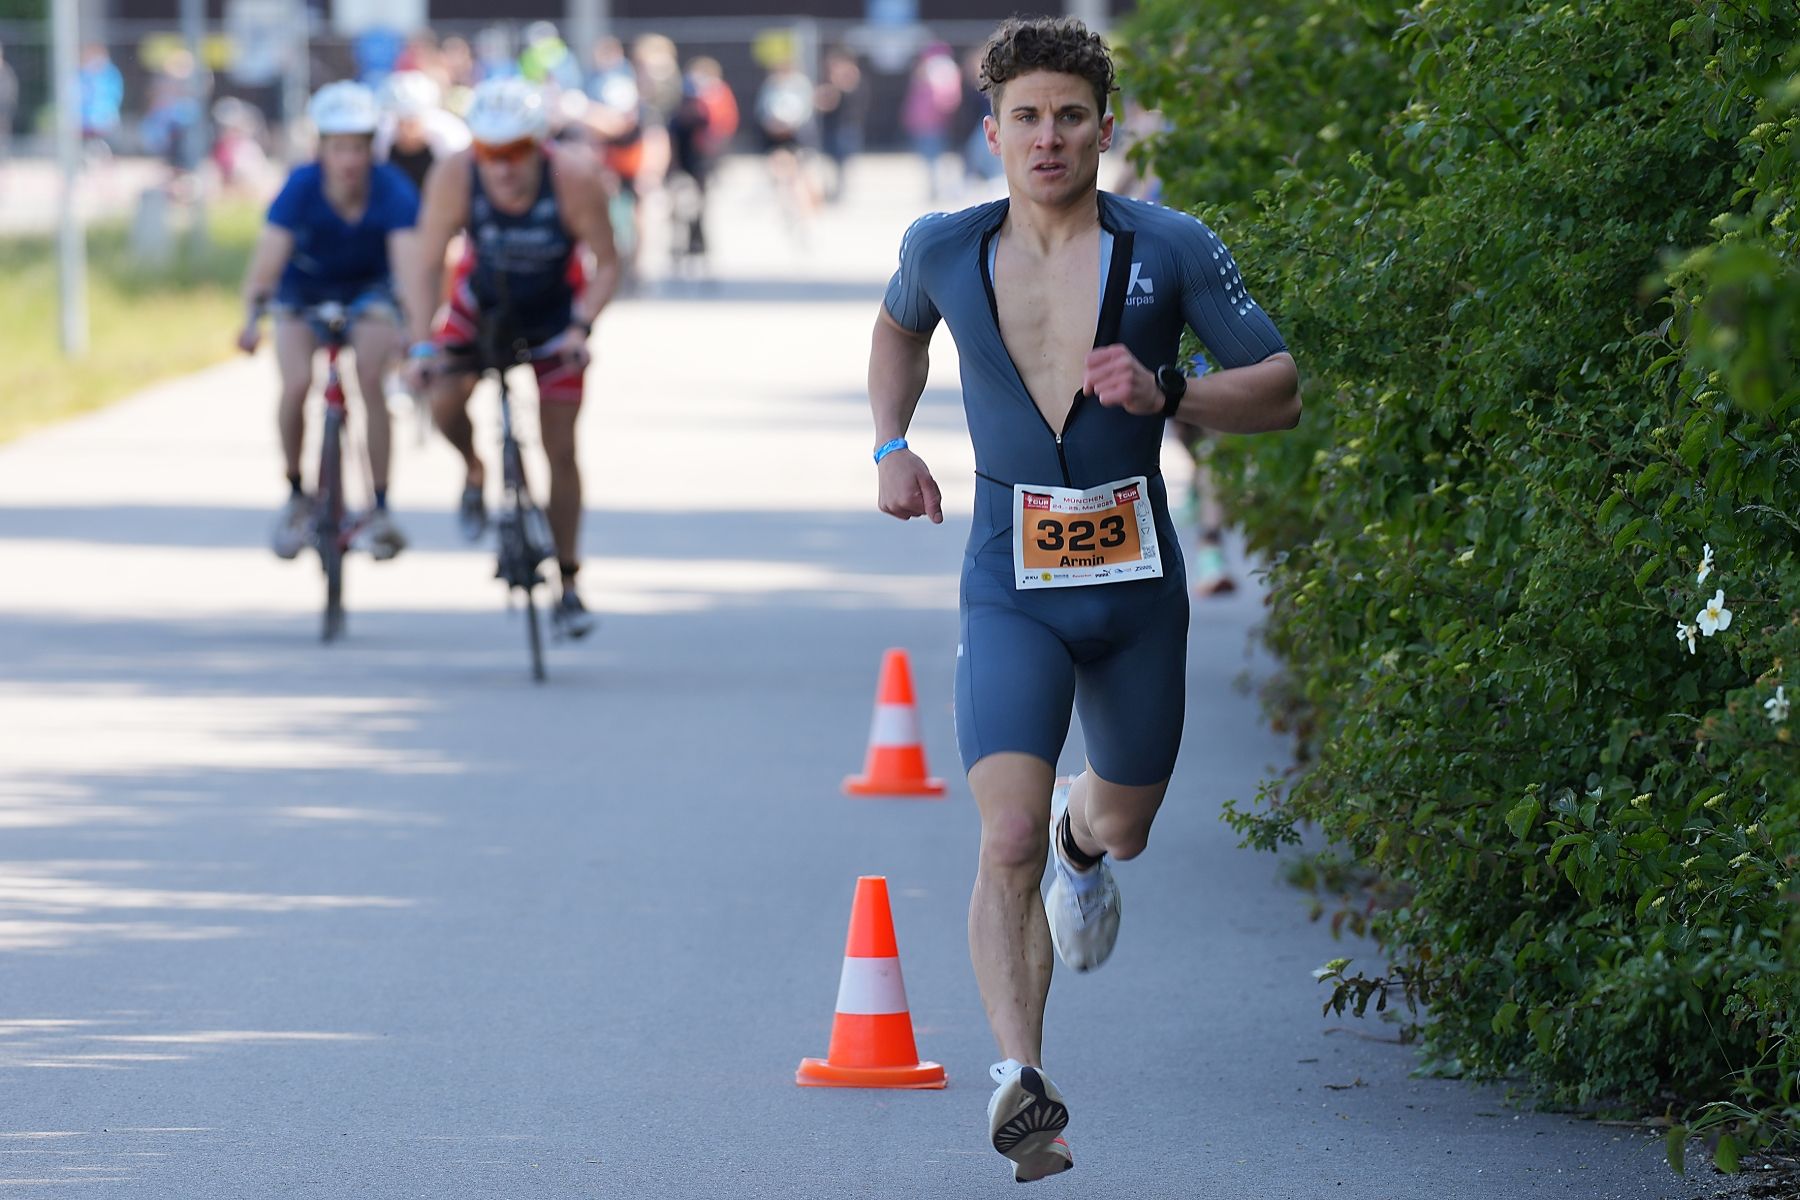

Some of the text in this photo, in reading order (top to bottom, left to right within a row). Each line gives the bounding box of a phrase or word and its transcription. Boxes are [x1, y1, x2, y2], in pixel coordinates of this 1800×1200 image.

[1124, 296, 1154, 307] urpas
[1037, 515, 1126, 551] 323
[1060, 555, 1105, 567] Armin
